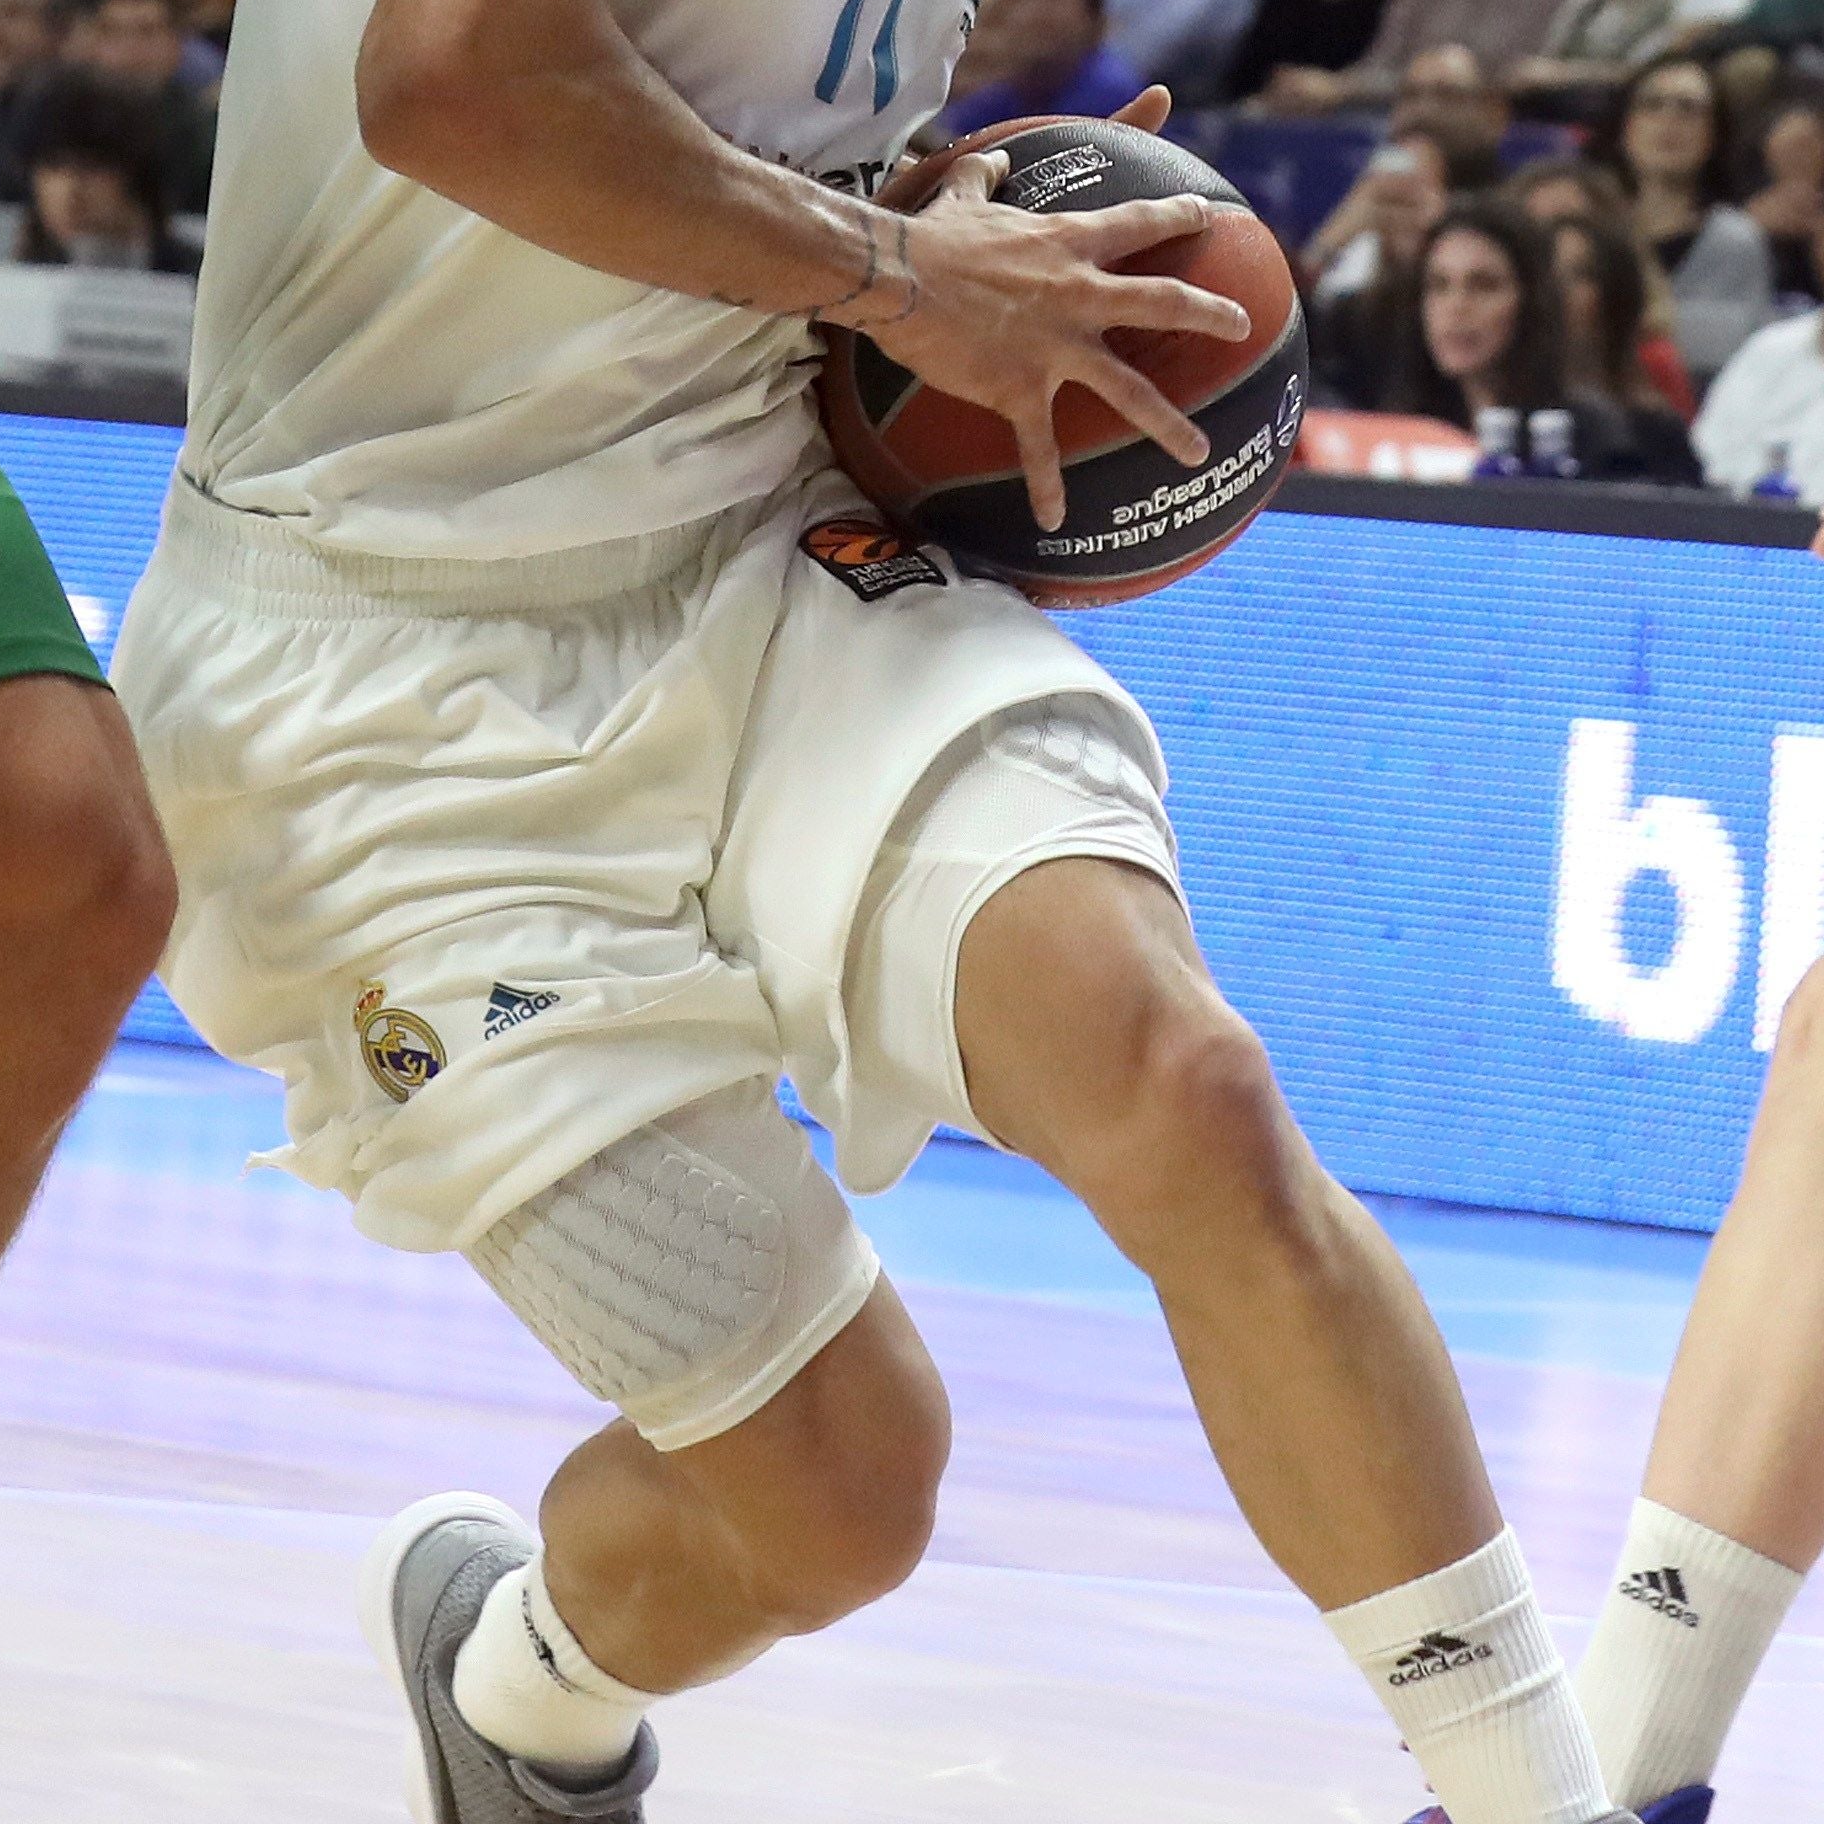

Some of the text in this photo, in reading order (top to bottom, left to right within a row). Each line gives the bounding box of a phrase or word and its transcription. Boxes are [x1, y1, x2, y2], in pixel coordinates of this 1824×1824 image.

[1111, 422, 1272, 525] EuroLeague
[1173, 448, 1275, 530] TURKISH
[1037, 517, 1169, 556] AIRLINES
[485, 990, 560, 1040] adidas
[1619, 1581, 1699, 1627] adidas
[1389, 1643, 1493, 1686] adidas
